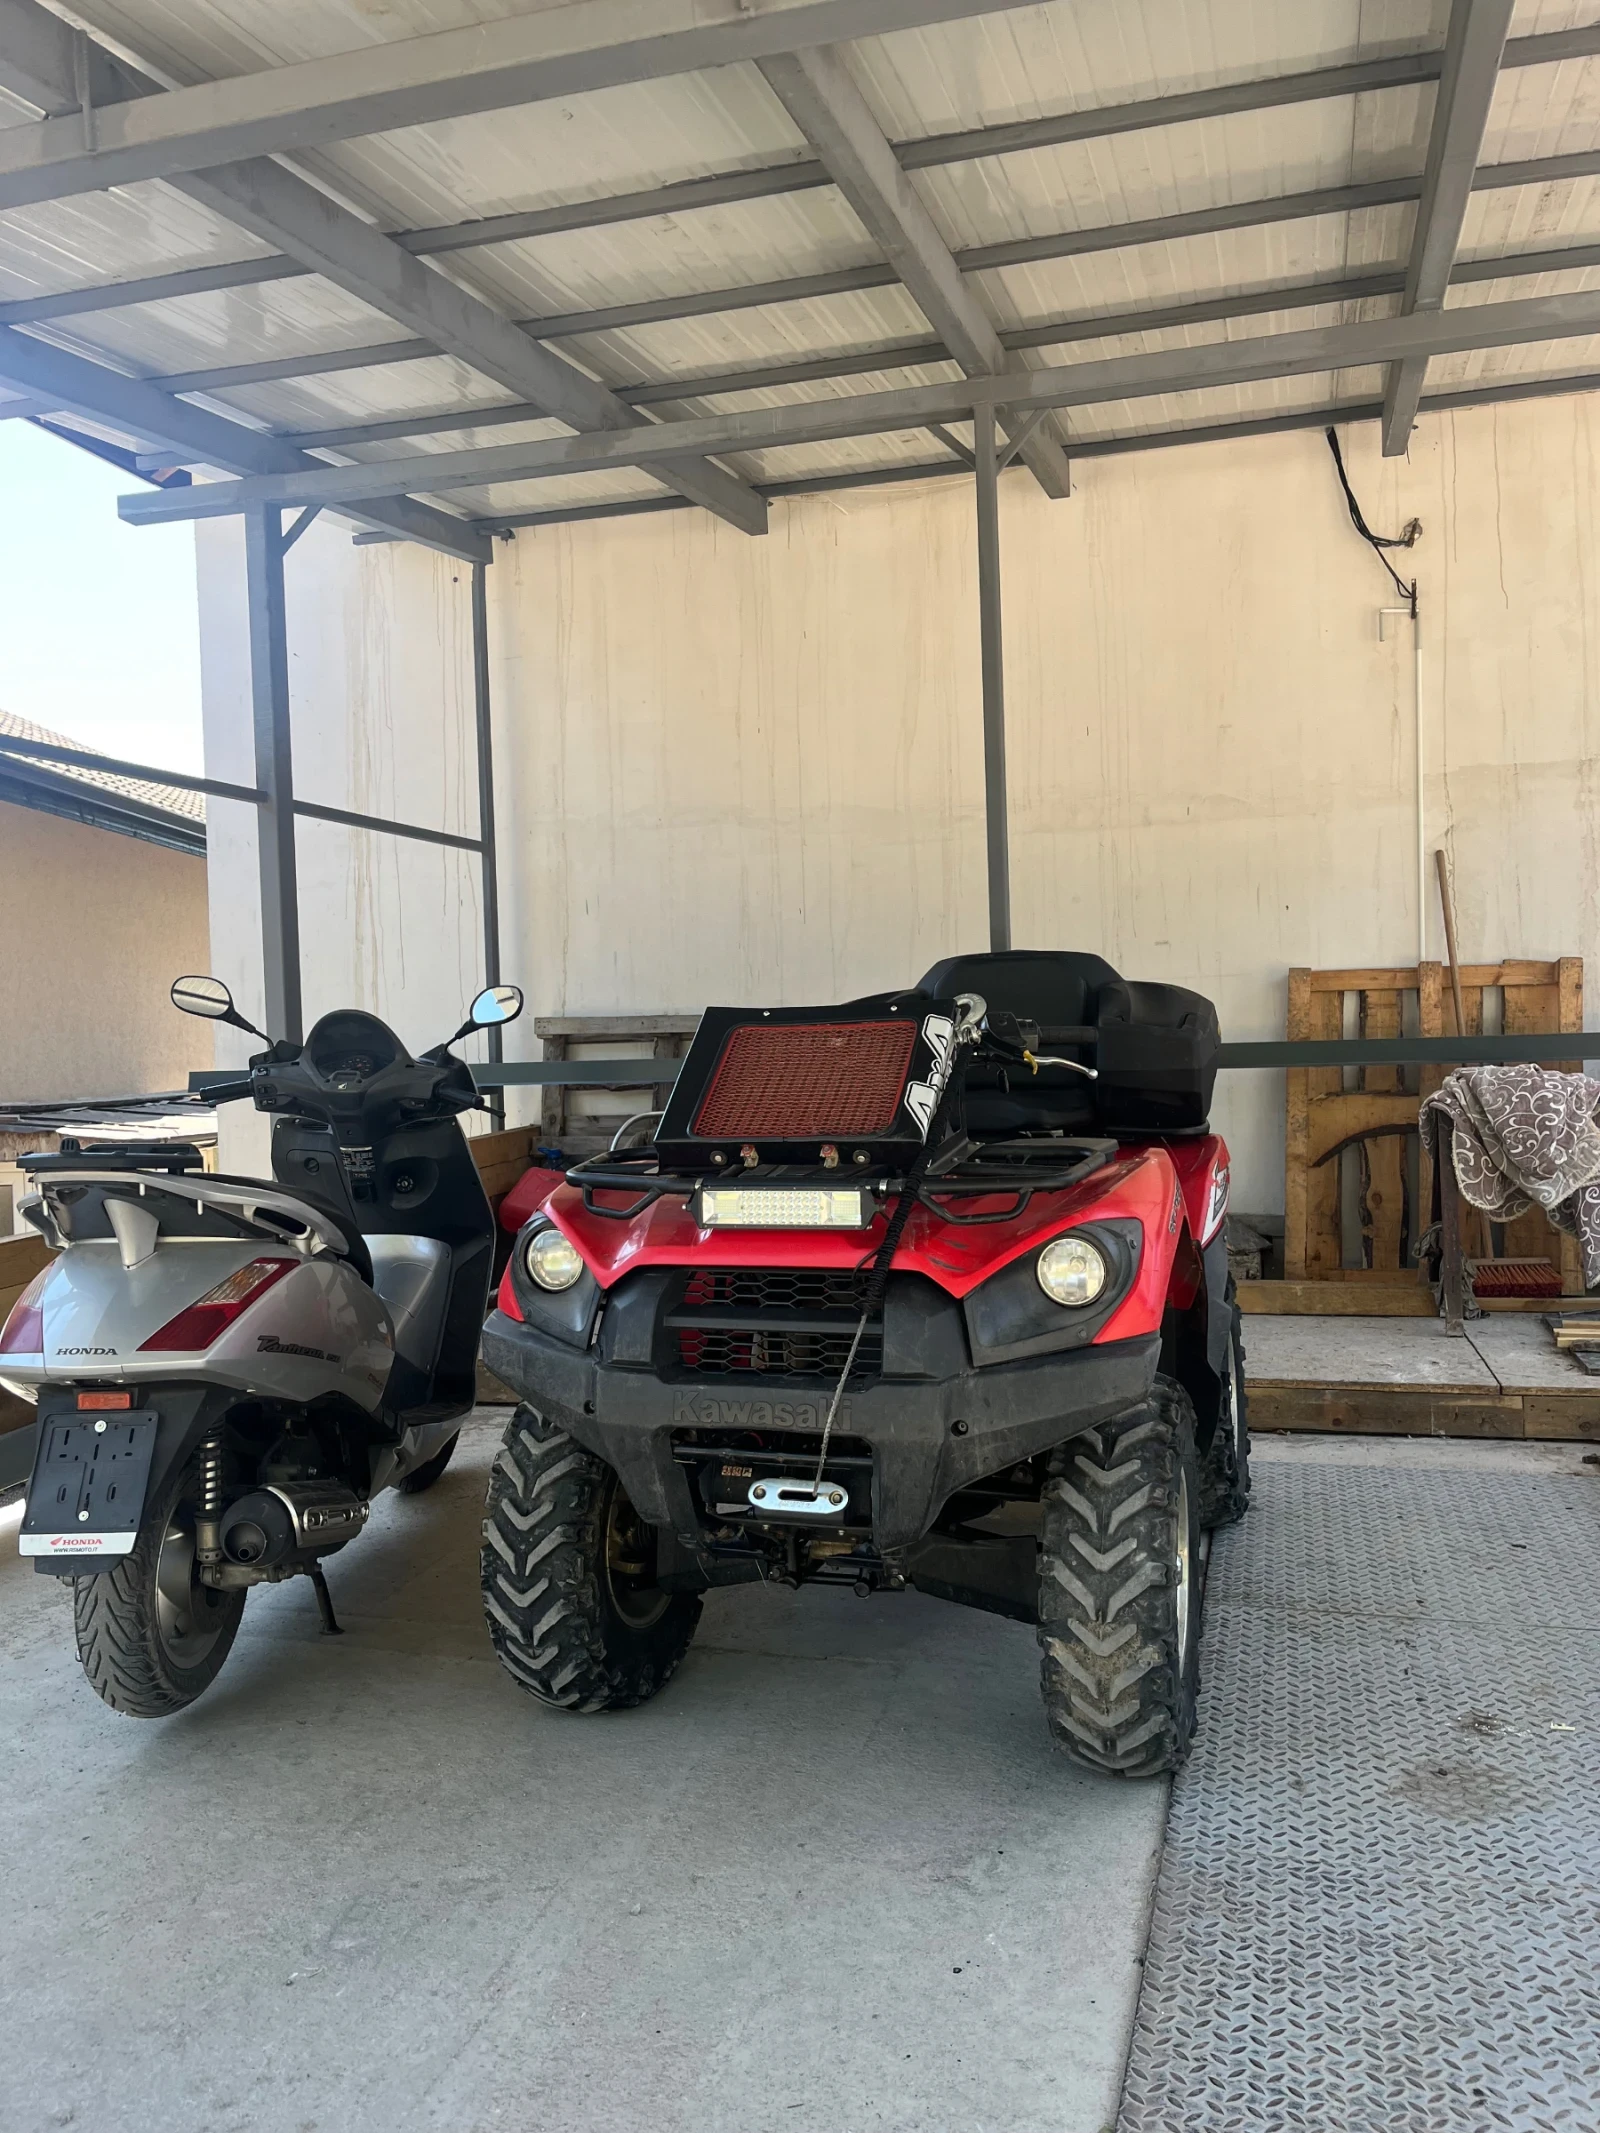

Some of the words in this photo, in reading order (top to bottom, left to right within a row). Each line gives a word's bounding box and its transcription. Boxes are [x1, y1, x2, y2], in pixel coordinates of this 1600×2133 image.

[56, 1347, 118, 1356] HONDA
[673, 1390, 852, 1430] Kawasaki
[62, 1538, 103, 1546] HONDA
